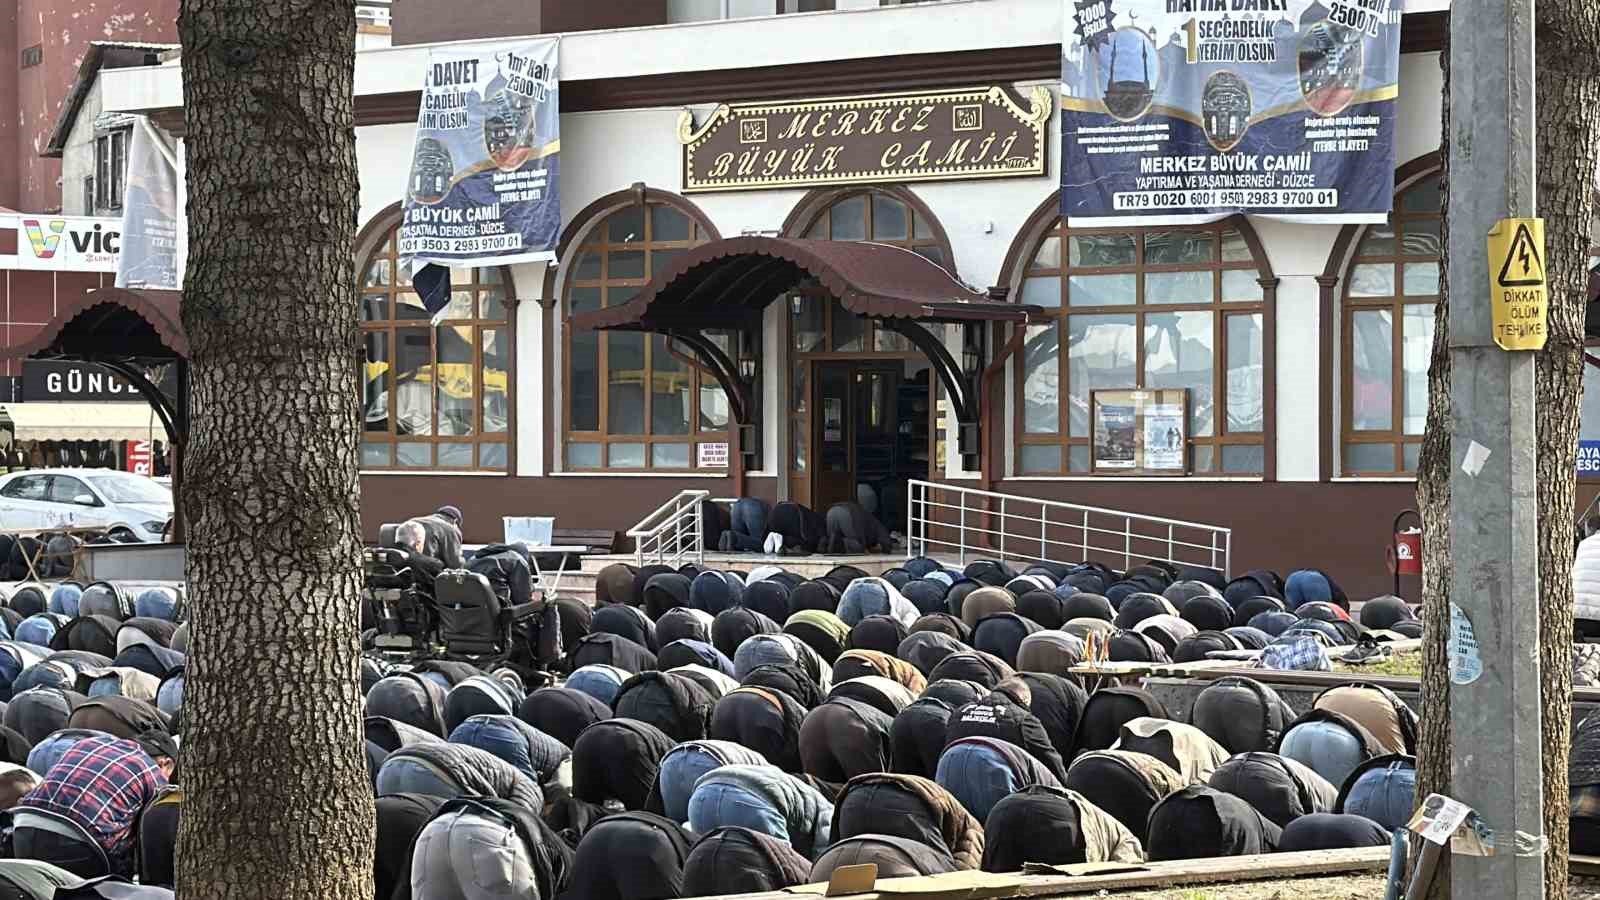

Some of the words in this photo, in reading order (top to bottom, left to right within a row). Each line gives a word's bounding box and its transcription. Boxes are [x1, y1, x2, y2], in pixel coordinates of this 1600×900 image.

[1079, 1, 1106, 24] 2000
[1329, 2, 1366, 29] 2500
[1368, 14, 1378, 35] TL
[1181, 17, 1196, 61] 1
[1199, 17, 1274, 39] SECCADELİK
[1199, 42, 1235, 61] YERİM
[1239, 43, 1275, 60] OLSUN
[434, 59, 479, 87] DAVET
[507, 74, 533, 96] 2500
[440, 111, 468, 129] OLSUN
[778, 105, 935, 139] MERKEZ
[708, 144, 844, 177] BÜYÜK
[881, 131, 1018, 168] CAMİİ
[1140, 156, 1206, 173] MERKEZ
[1210, 152, 1258, 171] BÜYÜK
[1263, 152, 1311, 171] CAMİİ
[1136, 175, 1183, 190] YAPTIRMA
[1184, 175, 1197, 188] VE
[1198, 174, 1234, 191] YAŞATMA
[1235, 172, 1275, 188] DERNEĞİ
[1282, 172, 1315, 187] DÜZCE
[1118, 194, 1150, 207] TR79
[1153, 193, 1186, 206] 0020
[1191, 192, 1216, 205] 6001
[1247, 191, 1278, 204] 2983
[1282, 191, 1314, 204] 9700
[1318, 191, 1333, 204] 01
[412, 205, 463, 223] BÜYÜK
[466, 202, 500, 221] CAMİİ
[440, 222, 476, 237] DERNEĞİ
[480, 221, 505, 235] DÜZCE
[482, 237, 505, 250] 9700
[508, 235, 518, 248] 01
[1511, 304, 1539, 320] ÖLÜM
